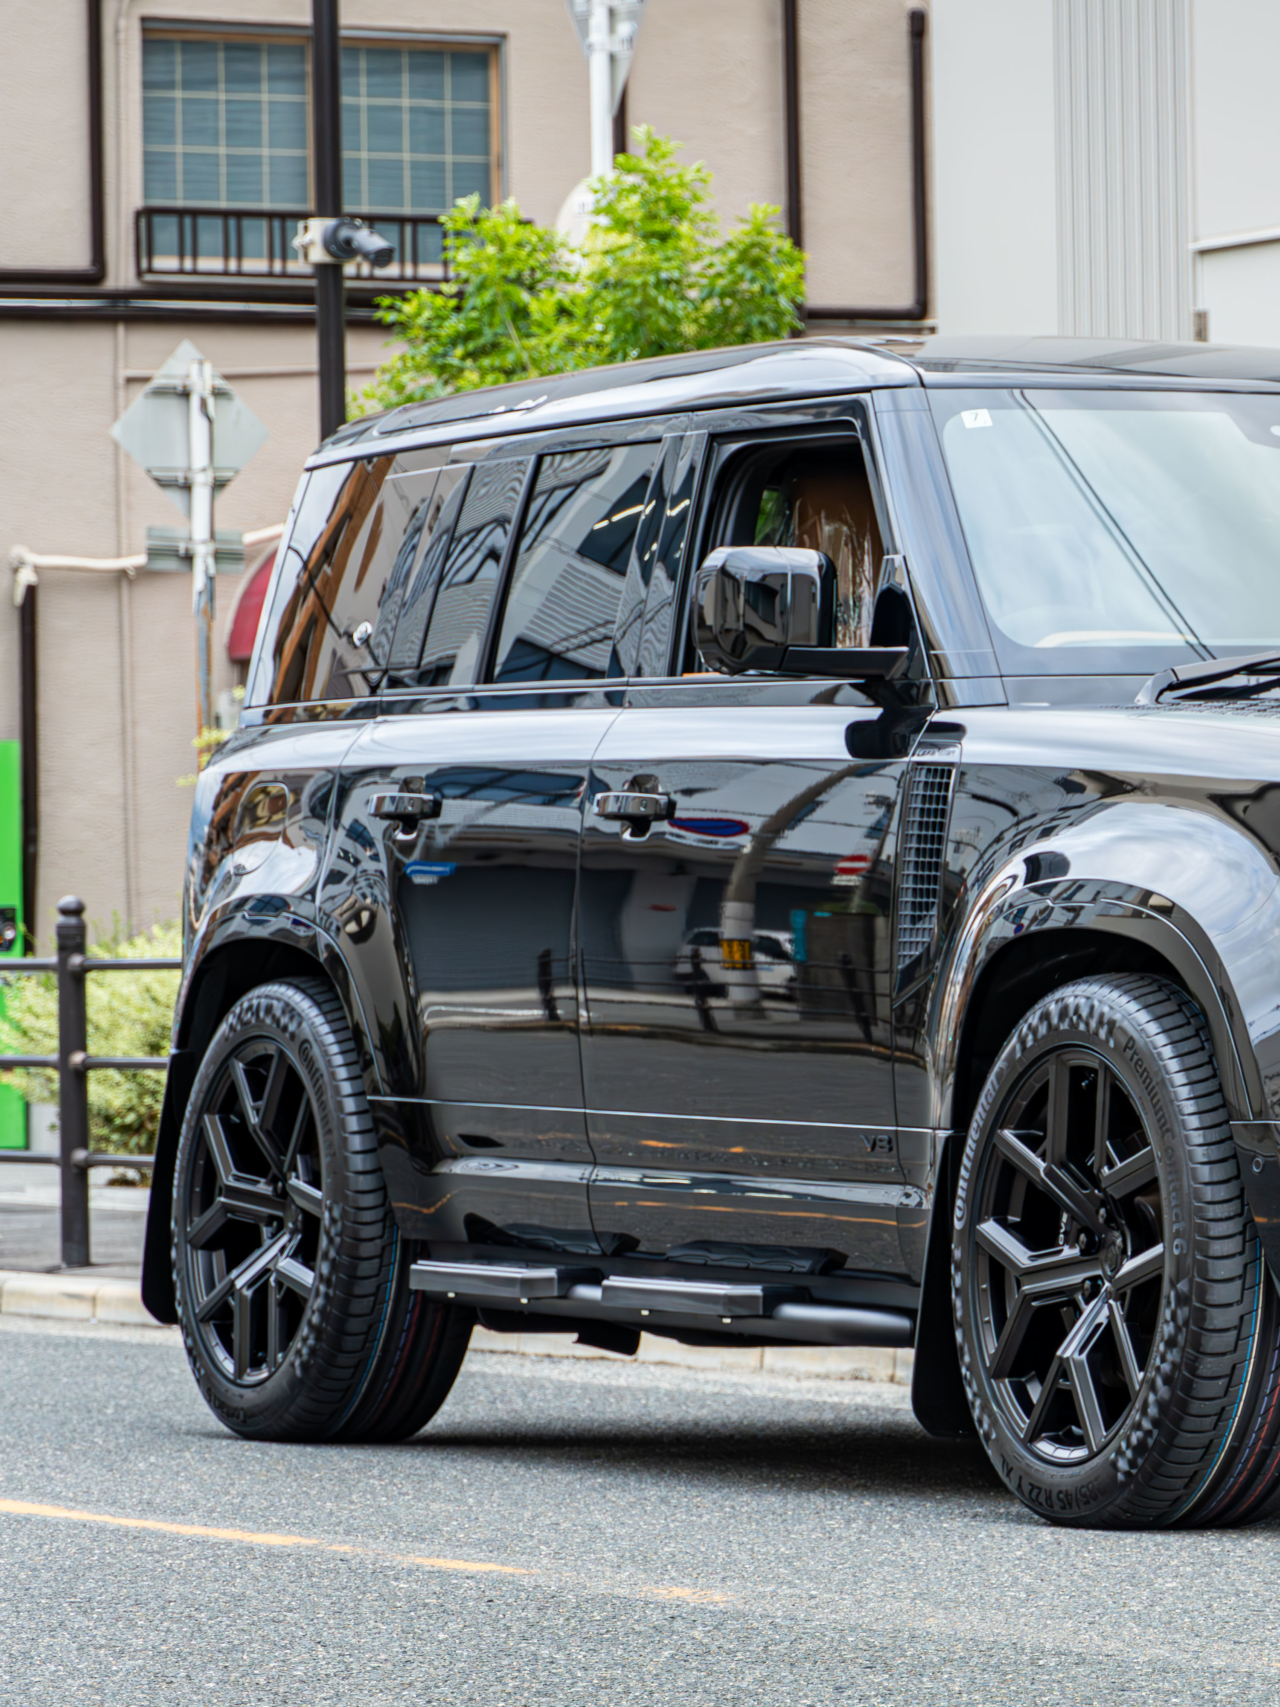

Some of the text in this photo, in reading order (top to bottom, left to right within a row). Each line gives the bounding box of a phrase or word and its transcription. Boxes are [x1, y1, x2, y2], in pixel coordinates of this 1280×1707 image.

[860, 1134, 893, 1152] V8
[954, 1075, 1002, 1230] Continental
[1056, 1481, 1102, 1510] 85/45
